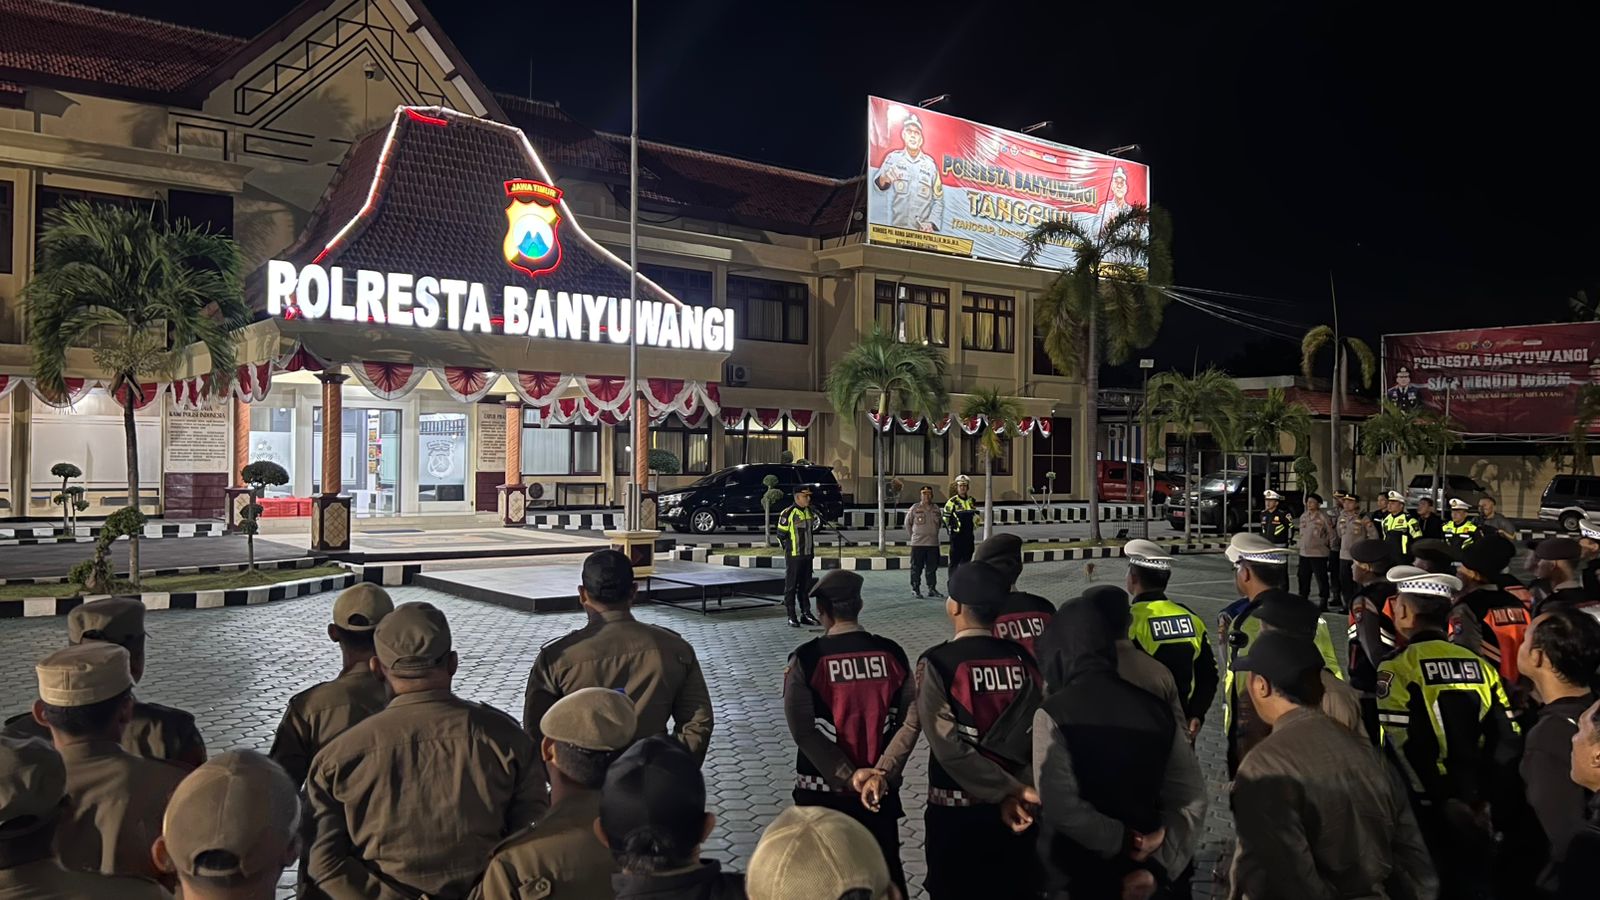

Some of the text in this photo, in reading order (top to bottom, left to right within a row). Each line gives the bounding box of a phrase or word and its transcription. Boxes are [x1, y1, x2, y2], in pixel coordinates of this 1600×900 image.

[511, 183, 556, 197] JAWA TIMUR
[943, 155, 1098, 207] POLRESTA BANYUWANGI
[268, 259, 735, 351] POLRESTA BANYUWANGI
[1413, 348, 1589, 369] POLRESTA BANYUWANGI
[996, 617, 1045, 640] POLISI
[1153, 617, 1194, 636] POLISI
[828, 656, 888, 682] POLISI
[1425, 661, 1480, 680] POLISI
